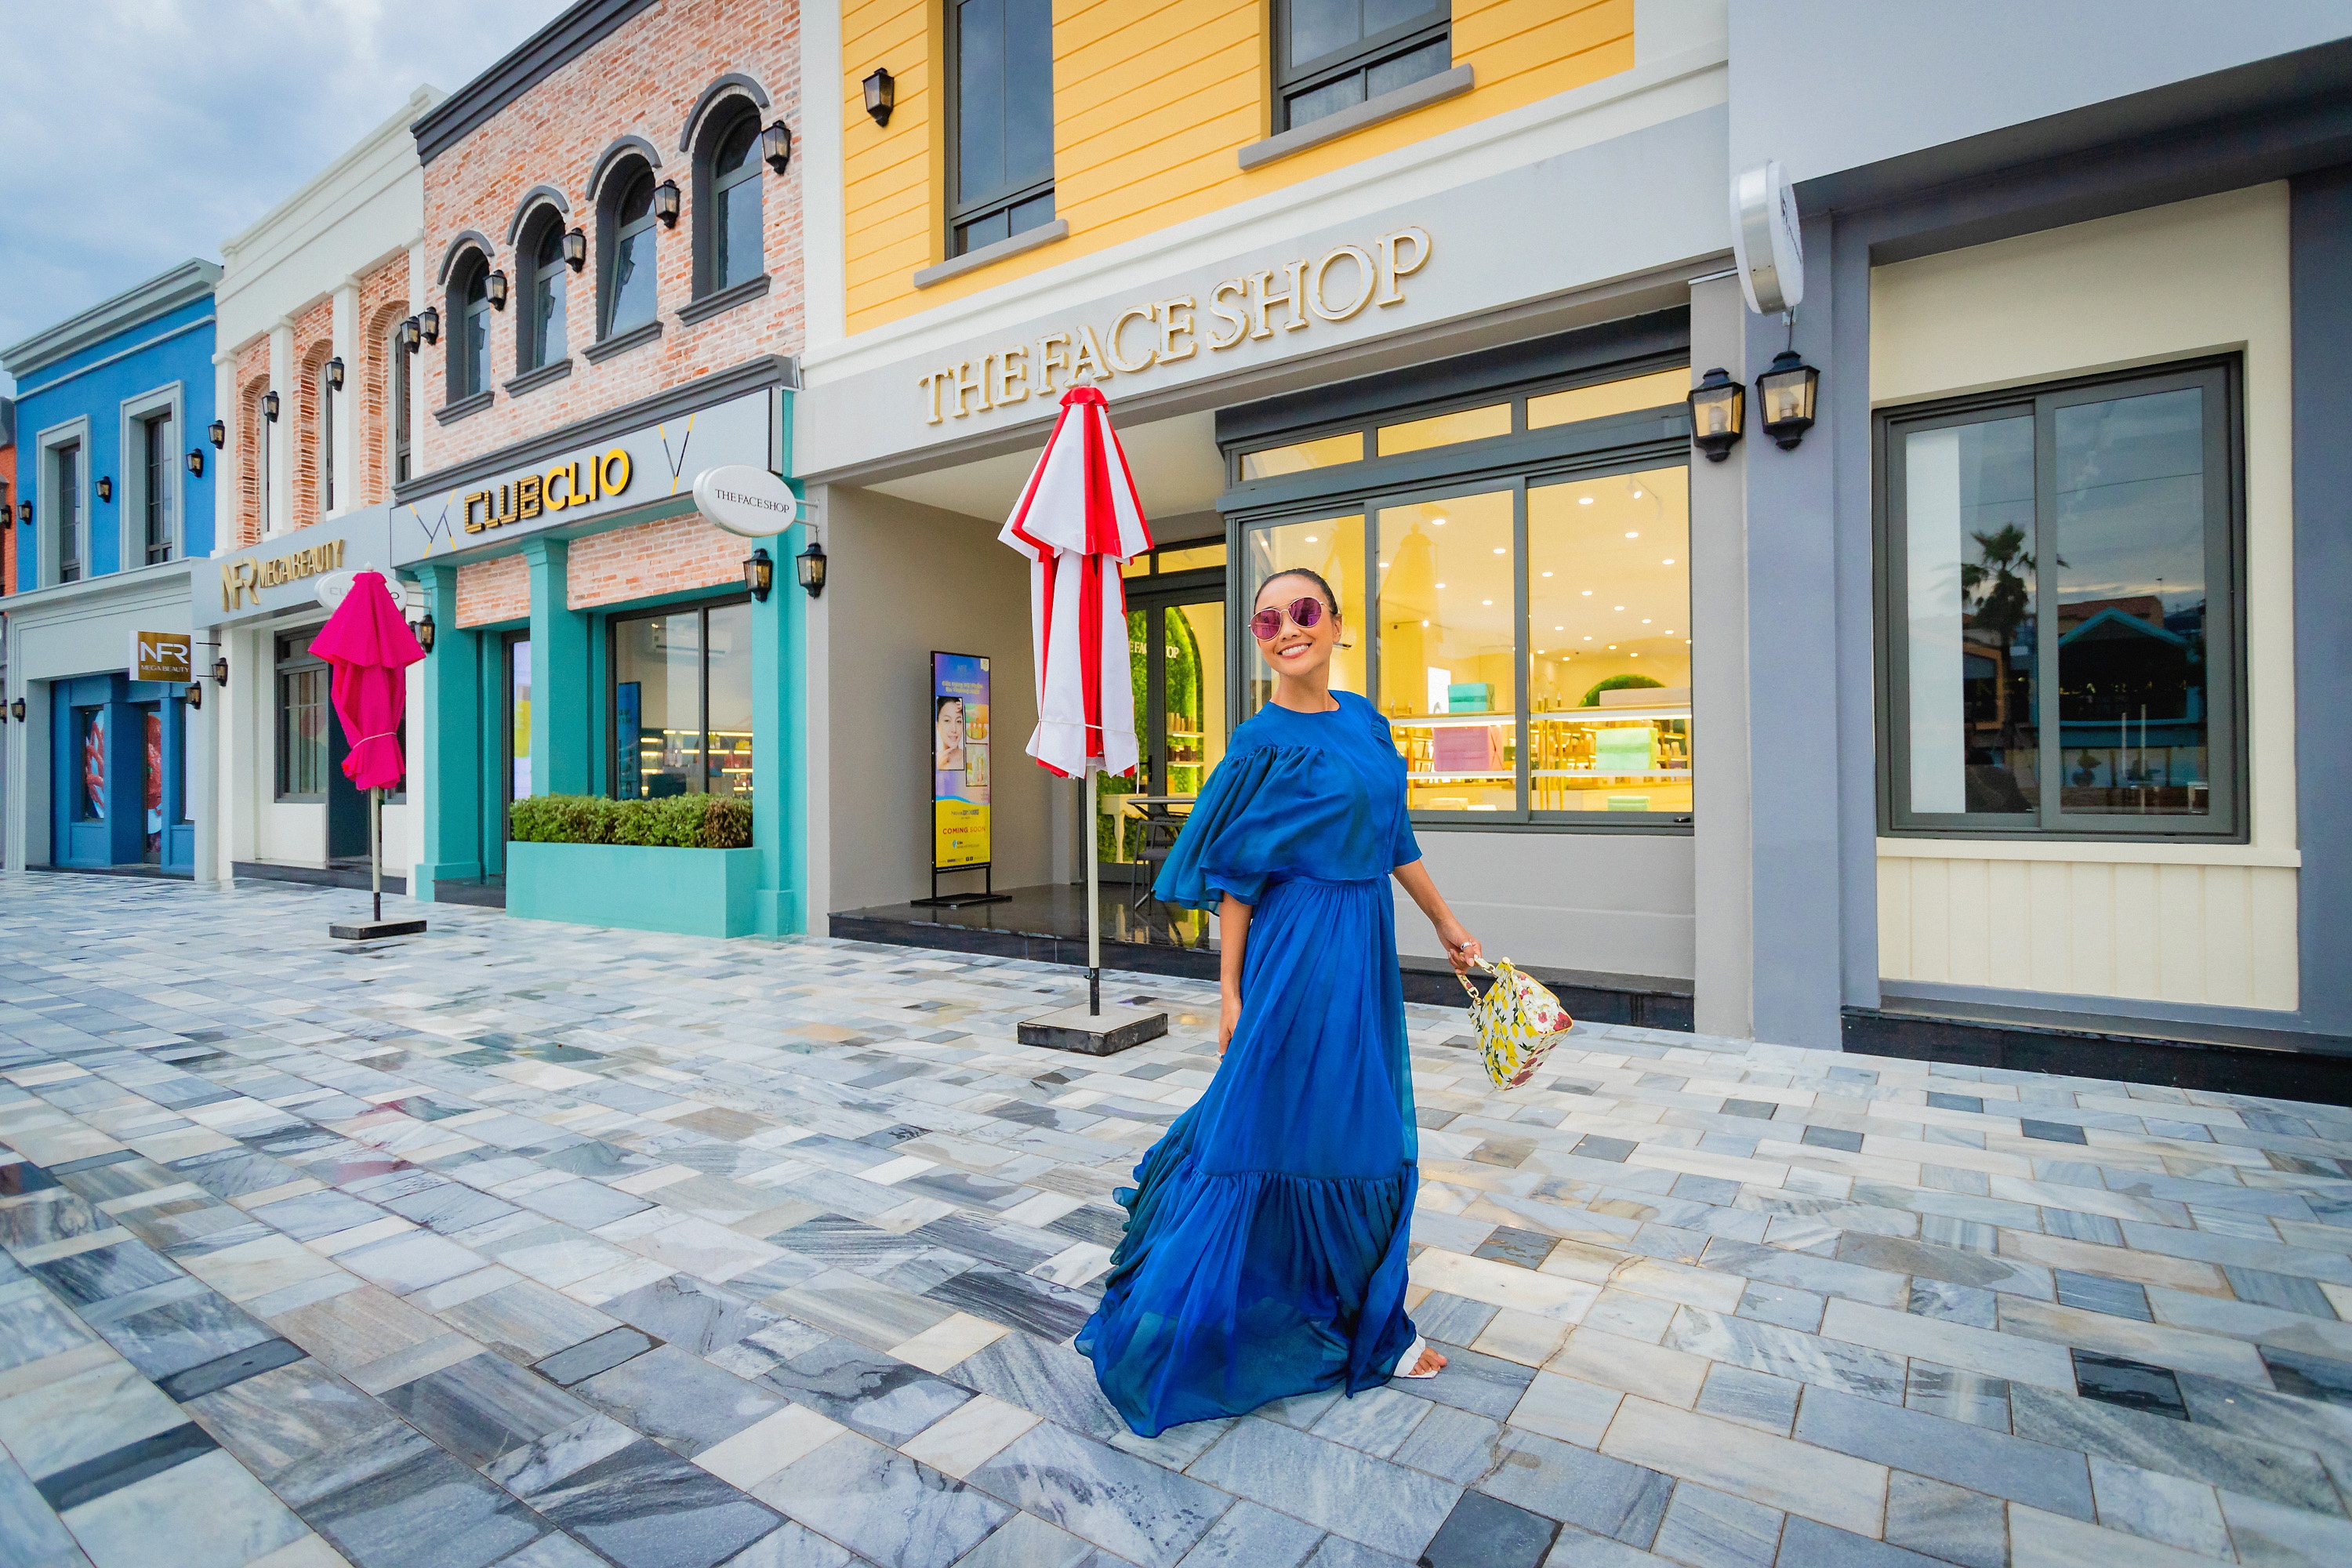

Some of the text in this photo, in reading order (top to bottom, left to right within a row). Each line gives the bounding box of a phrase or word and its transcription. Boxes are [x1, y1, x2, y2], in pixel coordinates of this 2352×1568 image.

[918, 226, 1432, 425] THE FACE SHOP
[715, 488, 789, 514] THE FACE SHOP
[221, 556, 260, 612] NFR
[140, 641, 189, 664] NFR
